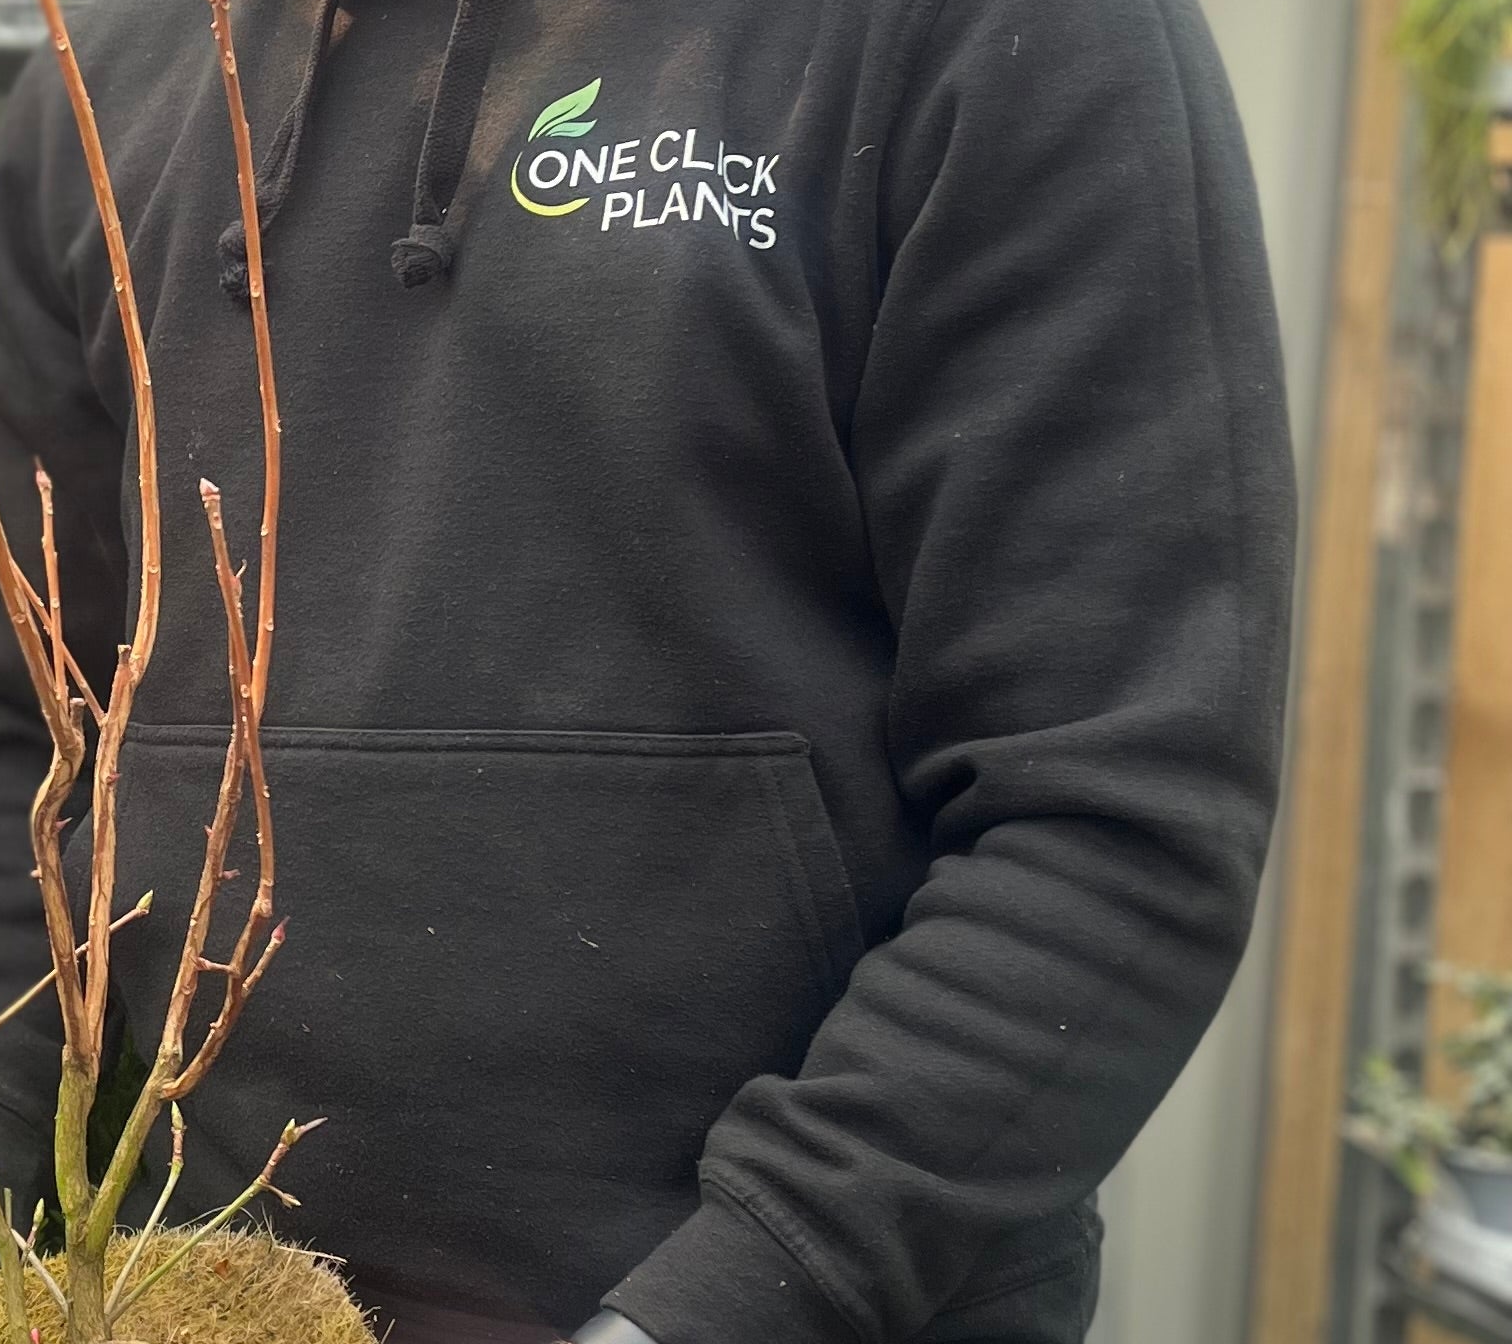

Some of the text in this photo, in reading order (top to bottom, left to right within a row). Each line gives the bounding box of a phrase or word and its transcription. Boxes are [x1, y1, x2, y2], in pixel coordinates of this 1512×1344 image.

[528, 128, 780, 197] ONE CLICK
[601, 181, 777, 250] PLANTS
